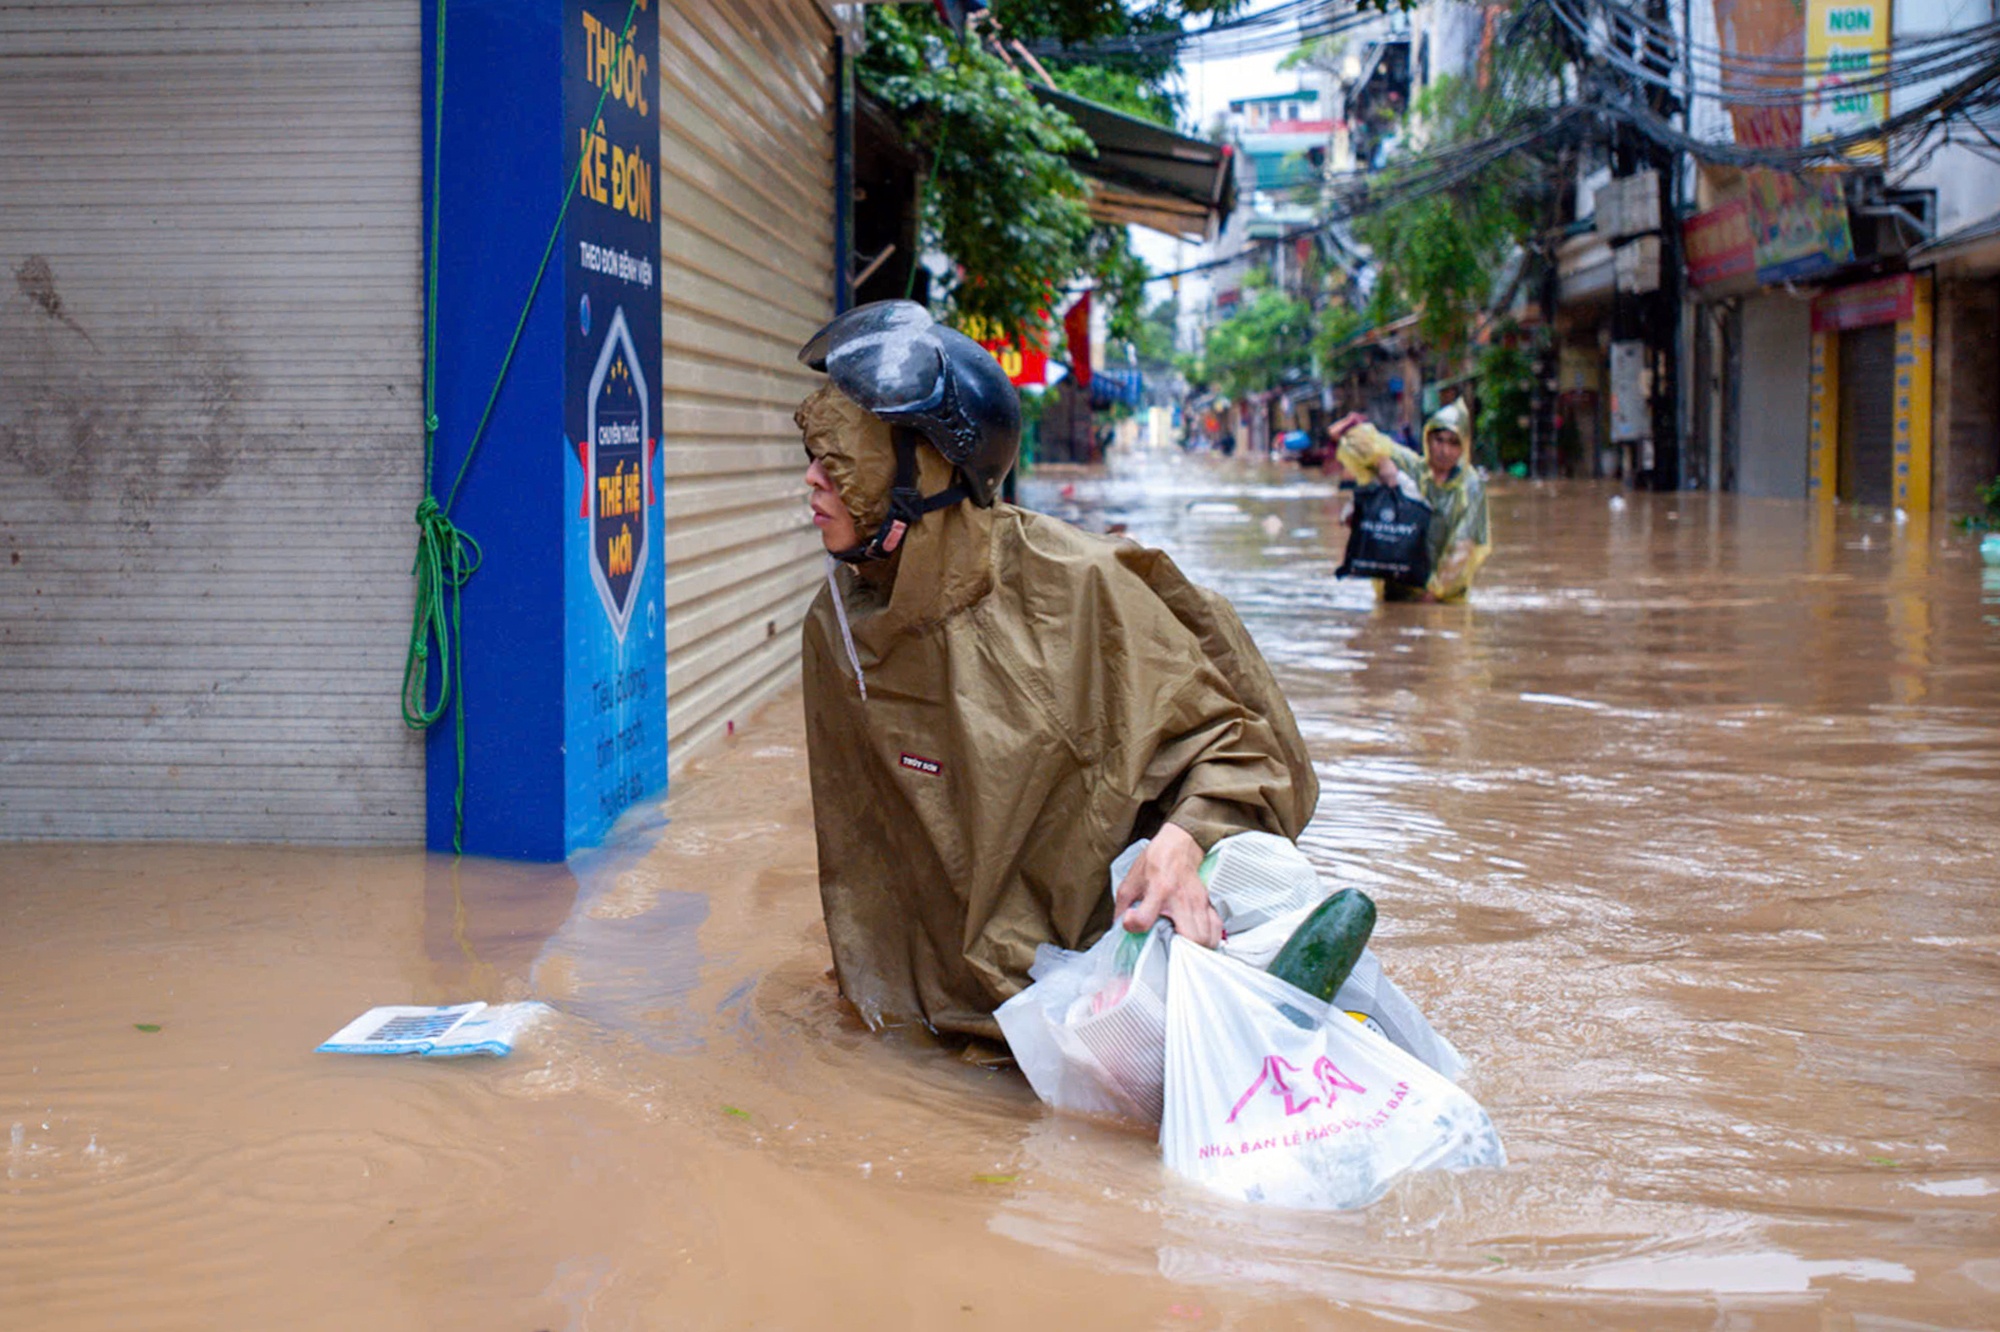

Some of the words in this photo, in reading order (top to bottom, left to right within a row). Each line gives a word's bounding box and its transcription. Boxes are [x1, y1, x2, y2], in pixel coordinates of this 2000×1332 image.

[1829, 8, 1871, 32] NON
[583, 10, 648, 116] THUỐC
[581, 118, 607, 204] KÊ
[611, 145, 651, 223] ĐƠN
[580, 241, 601, 271] THEO
[601, 247, 618, 276] ĐƠN
[619, 250, 638, 285] BỆNH
[638, 257, 652, 290] VIỆN
[598, 459, 623, 518] THẾ
[624, 462, 640, 522] HỆ
